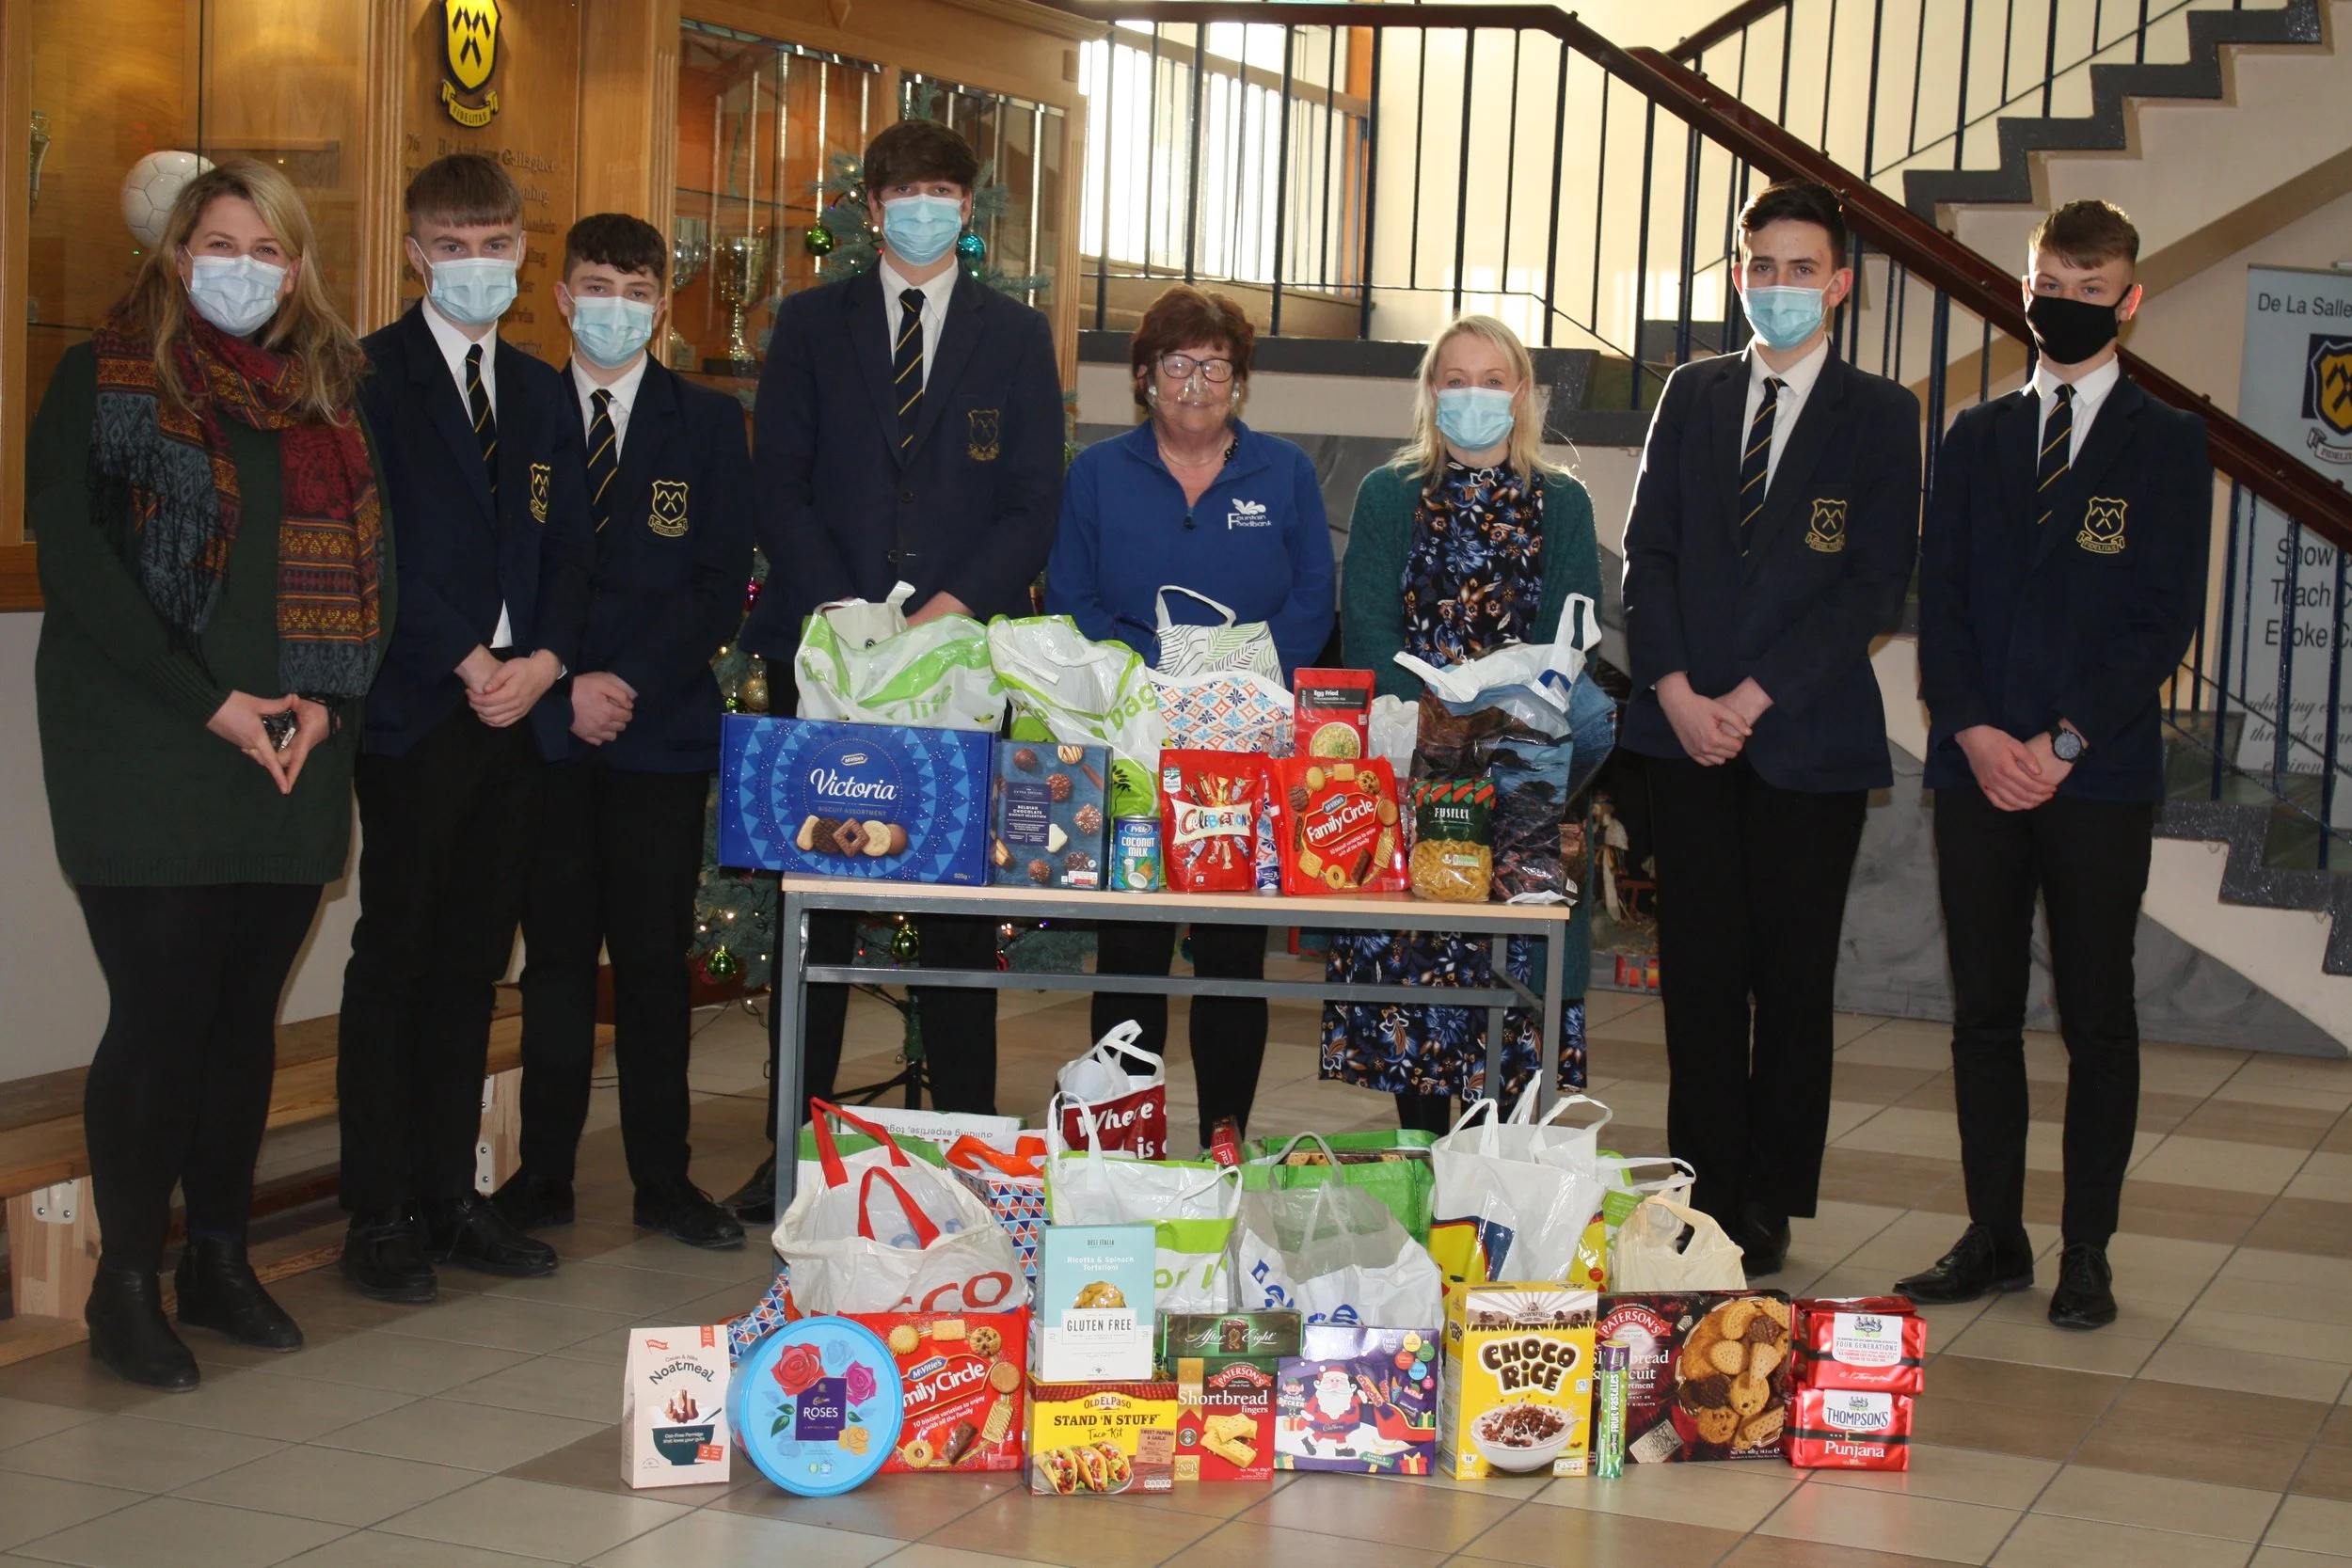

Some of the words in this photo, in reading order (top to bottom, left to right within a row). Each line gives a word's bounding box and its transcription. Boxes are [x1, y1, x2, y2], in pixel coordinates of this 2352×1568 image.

[453, 106, 487, 124] FIDELITAS
[2258, 293, 2281, 312] De
[2286, 294, 2306, 314] La
[2312, 296, 2352, 318] Salle
[2320, 449, 2352, 460] FIDELIT
[2265, 619, 2328, 648] Eoke
[810, 768, 898, 800] Victoria
[818, 806, 843, 815] BISCUIT
[844, 807, 887, 816] ASSORTMENT
[1434, 807, 1470, 819] FUSILLI
[1306, 815, 1343, 843] Family
[1342, 799, 1375, 824] Circle
[1121, 836, 1154, 847] COCONUT
[1128, 847, 1148, 857] MILK
[1104, 1256, 1135, 1265] Spinach
[1067, 1320, 1104, 1332] GLUTEN
[1108, 1319, 1132, 1331] FREE
[1601, 1311, 1661, 1336] PATERSON'S
[1185, 1328, 1226, 1348] After
[1242, 1328, 1278, 1347] Eight
[1854, 1341, 1898, 1351] GENERATIONS
[1483, 1338, 1577, 1370] CHOCO
[649, 1360, 715, 1386] Noatmeal
[913, 1359, 943, 1380] McVitie's
[1217, 1367, 1264, 1386] PATERSON'S
[903, 1382, 937, 1408] mily
[936, 1361, 986, 1391] Circle
[1178, 1389, 1269, 1406] Shortbread
[803, 1406, 839, 1420] ROSES
[921, 1413, 940, 1425] biscuit
[940, 1405, 962, 1418] varieties
[969, 1395, 986, 1406] enjoy
[1241, 1404, 1269, 1415] fingers
[1826, 1407, 1889, 1427] THOMPSON'S
[926, 1421, 939, 1431] with
[946, 1414, 956, 1423] the
[956, 1407, 974, 1418] family
[1054, 1415, 1097, 1426] STAND
[1100, 1414, 1112, 1425] 'N
[1116, 1414, 1158, 1425] STUFF
[1088, 1428, 1106, 1440] Taco
[1107, 1427, 1123, 1439] Kit
[1824, 1440, 1884, 1458] Punjana
